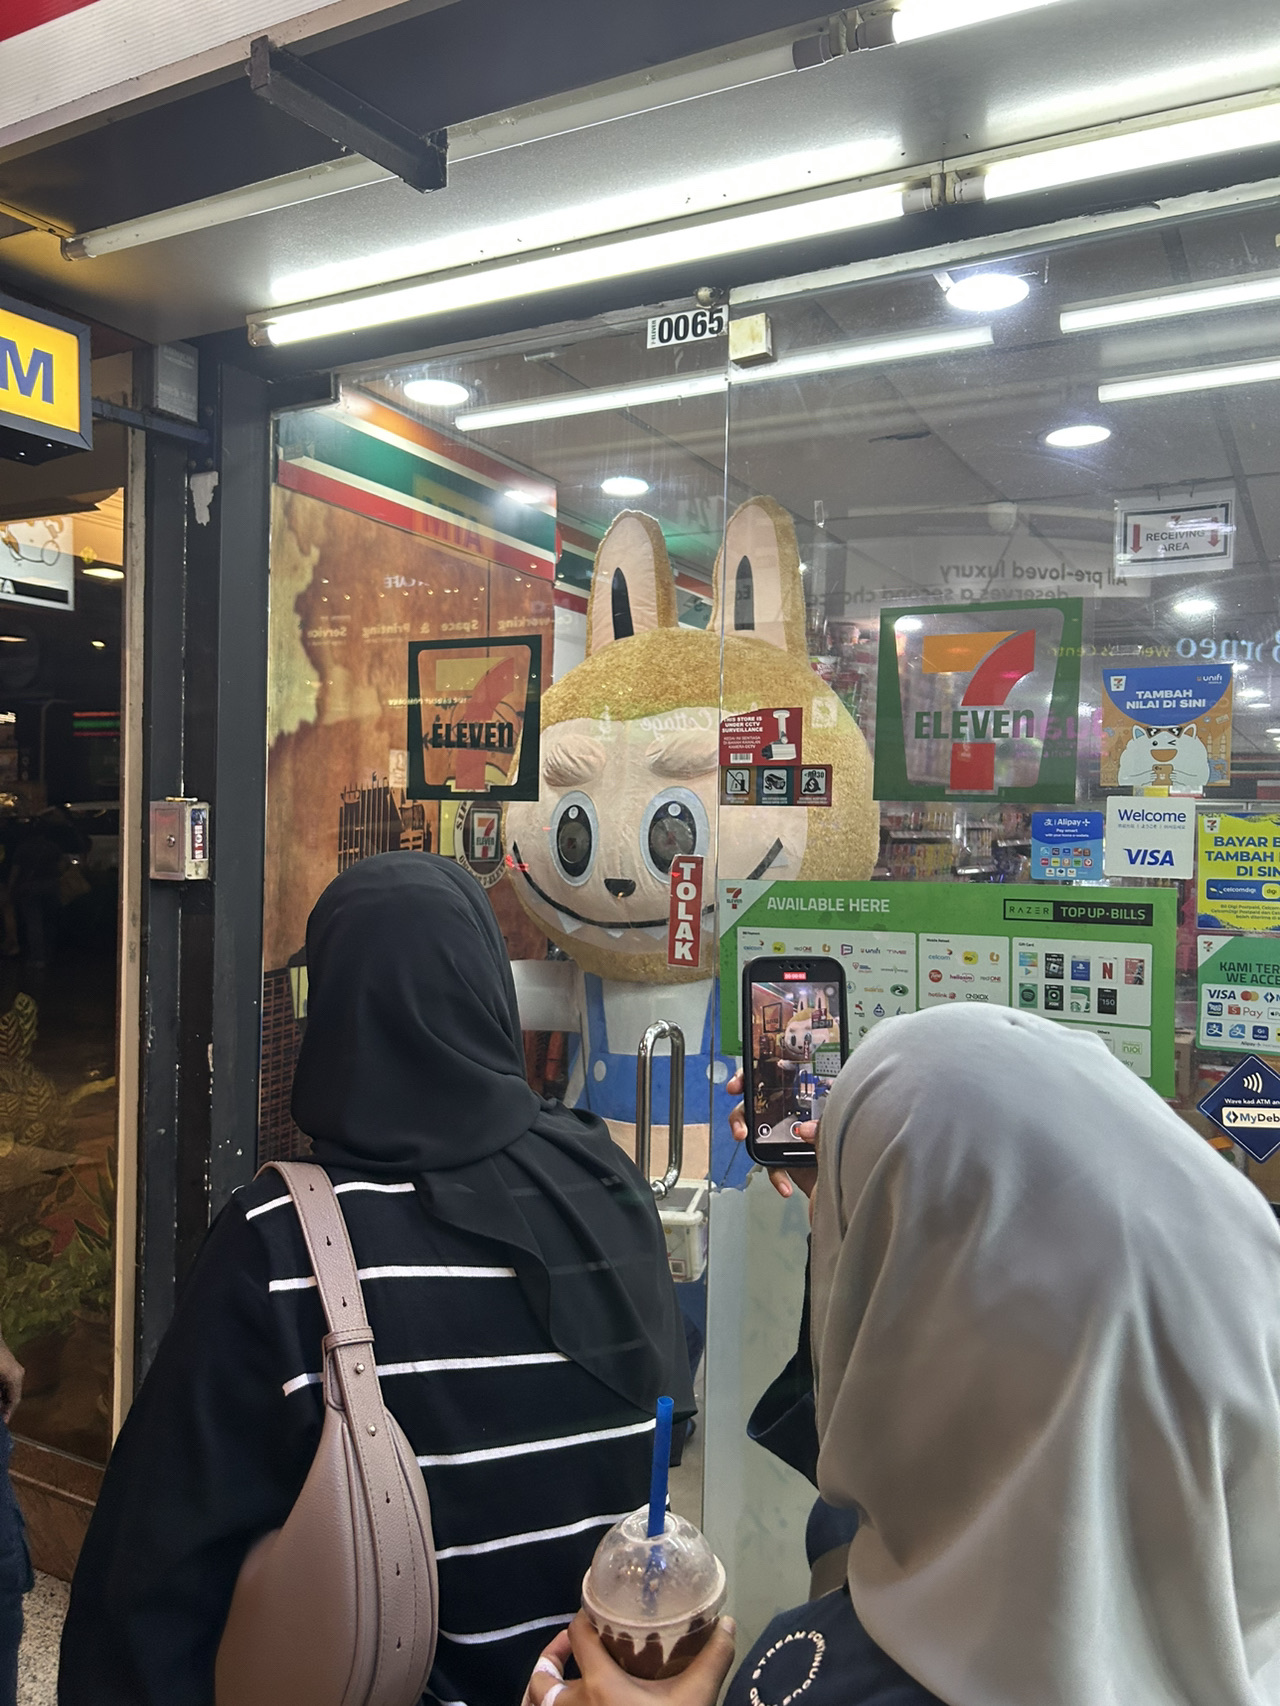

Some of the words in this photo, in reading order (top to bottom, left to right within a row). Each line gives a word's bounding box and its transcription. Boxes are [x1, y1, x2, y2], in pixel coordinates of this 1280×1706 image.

[658, 308, 723, 343] 0065
[0, 336, 54, 404] M
[1146, 530, 1205, 541] RECEIVING
[1162, 542, 1189, 552] AREA
[1203, 673, 1222, 681] unifi
[1136, 689, 1192, 699] TAMBAH
[1126, 700, 1159, 709] NILAI
[1163, 700, 1176, 708] DI
[1180, 699, 1205, 708] SINI
[1118, 809, 1187, 822] Welcome
[1213, 836, 1268, 848] BAYAR
[1123, 848, 1175, 866] VISA
[1205, 851, 1274, 862] TAMBAH
[1236, 865, 1253, 876] DI
[1222, 886, 1256, 894] celcomdigi
[767, 896, 844, 912] AVAILABLE
[849, 898, 890, 913] HERE
[674, 862, 697, 961] TOLAK
[1220, 962, 1252, 973] KAMI
[1226, 973, 1247, 983] WE
[1206, 989, 1236, 1000] VISA
[1243, 1007, 1263, 1019] Pay
